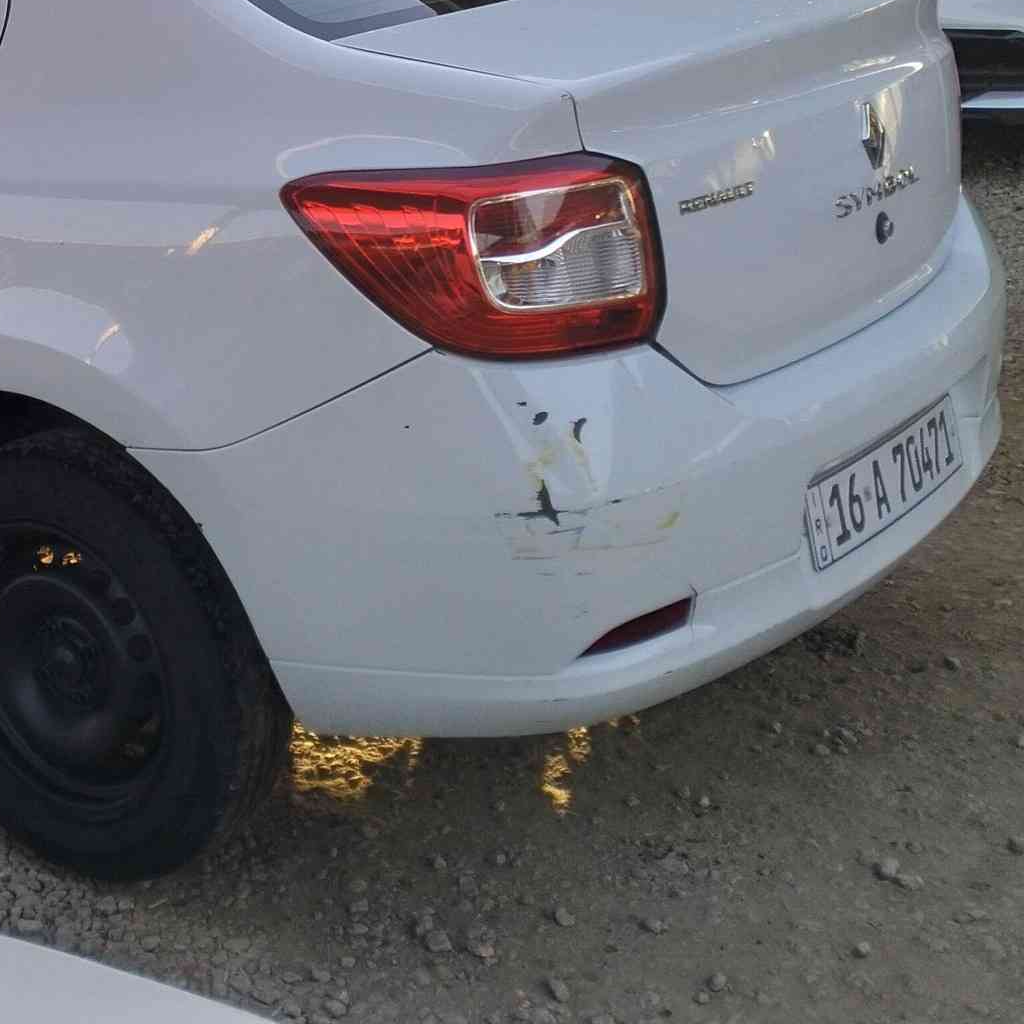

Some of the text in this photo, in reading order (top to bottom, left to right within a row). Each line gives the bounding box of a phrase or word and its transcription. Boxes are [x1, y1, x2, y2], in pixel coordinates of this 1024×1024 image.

[678, 180, 755, 216] RENAULT
[834, 165, 920, 219] SYMBOL
[829, 410, 955, 547] 16 A 70471
